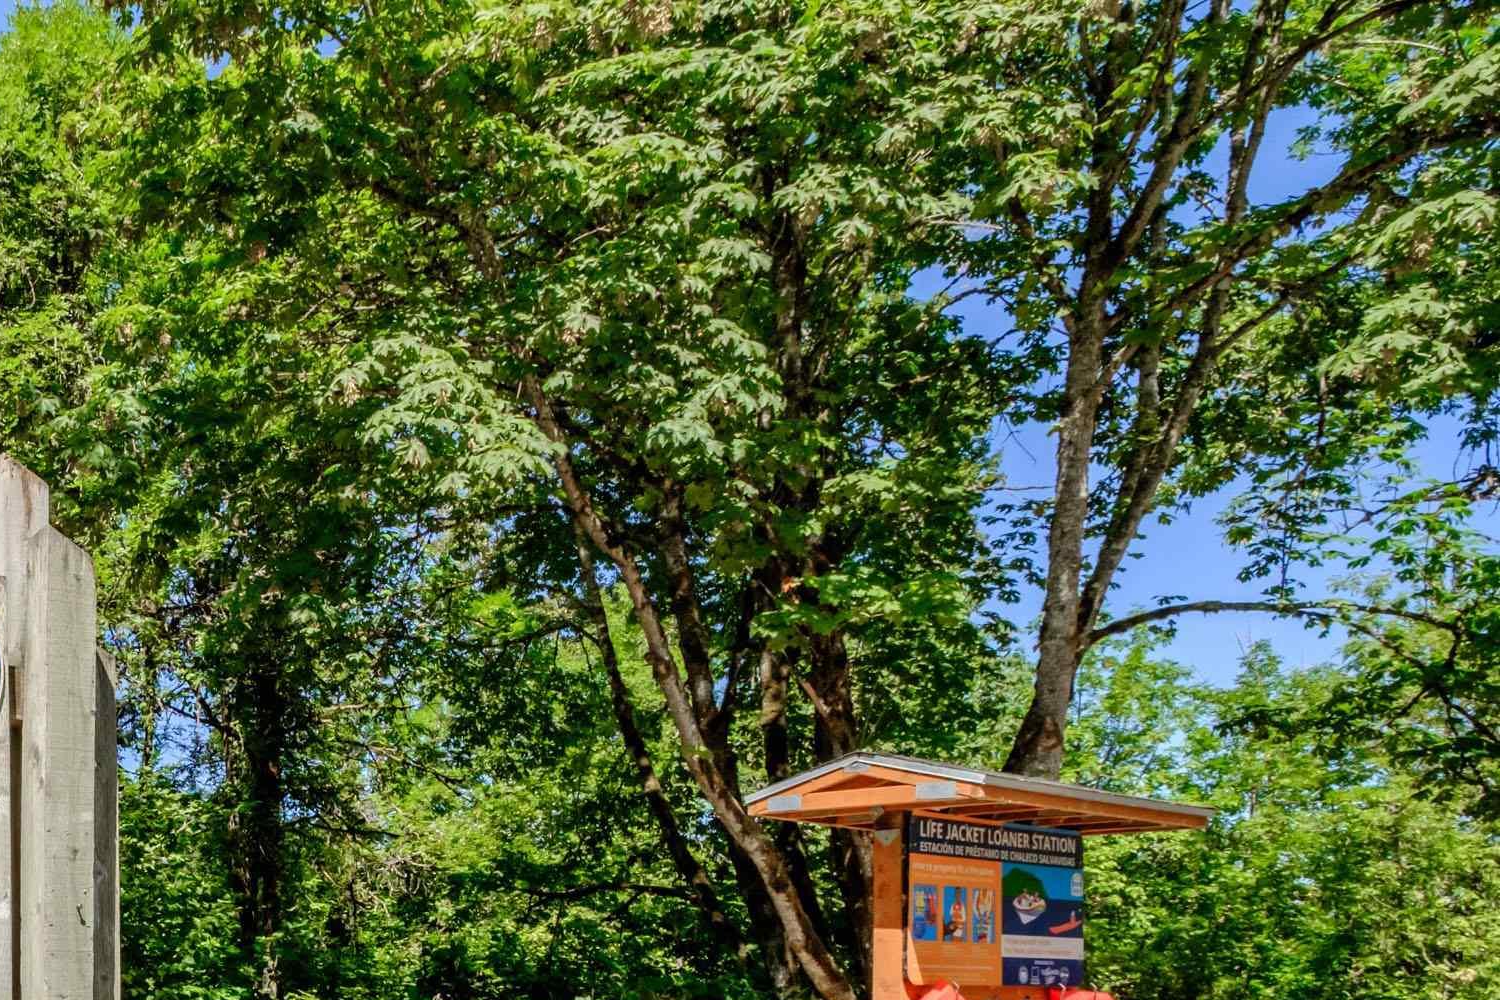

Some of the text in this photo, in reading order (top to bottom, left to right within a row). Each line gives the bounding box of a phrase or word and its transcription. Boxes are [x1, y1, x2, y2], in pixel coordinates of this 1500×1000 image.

[919, 820, 1077, 854] LIFE JACKET LOANER STATION
